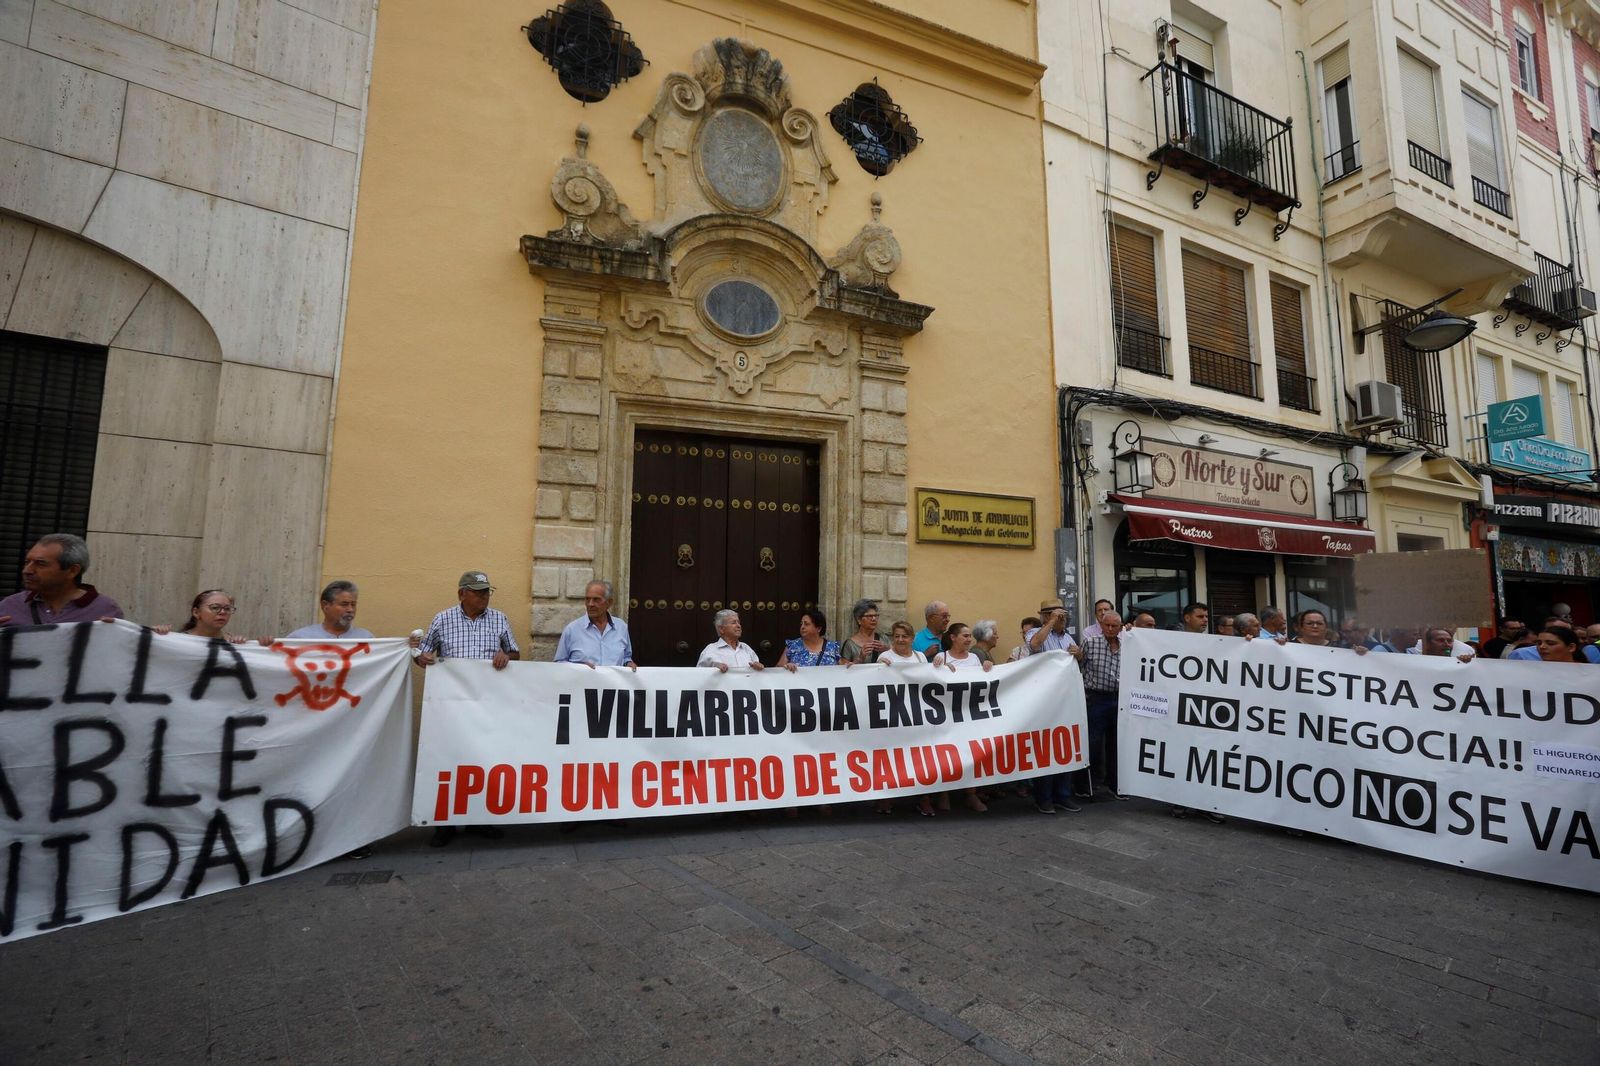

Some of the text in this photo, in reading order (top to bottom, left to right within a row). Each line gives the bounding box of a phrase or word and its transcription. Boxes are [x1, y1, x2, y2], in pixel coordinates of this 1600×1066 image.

[739, 356, 746, 367] 5
[1182, 450, 1236, 486] Norte
[1240, 467, 1251, 495] y
[1253, 462, 1284, 492] Sur
[942, 509, 969, 521] JUNTA
[972, 511, 982, 523] DE
[1495, 504, 1542, 517] PIZZERIA
[942, 525, 1029, 539] Delegación del Gobierno
[1168, 519, 1213, 539] Pintxos
[1322, 536, 1352, 552] Tapas
[1130, 692, 1168, 703] VILLARRUBIA
[1140, 653, 1600, 726] ¡¡CON NUESTRA SALUD
[585, 688, 859, 738] VILLARRUBIA
[868, 679, 1002, 729] EXISTE!
[1184, 697, 1524, 772] NO SE NEGOCIA!!
[1533, 748, 1600, 762] EL HIGUERÓN
[434, 724, 1082, 821] ¡POR UN CENTRO DE SALUD NUEVO!
[1536, 764, 1600, 779] ENCINAREJO
[1138, 737, 1600, 860] EL MÉDICO NO SE VA
